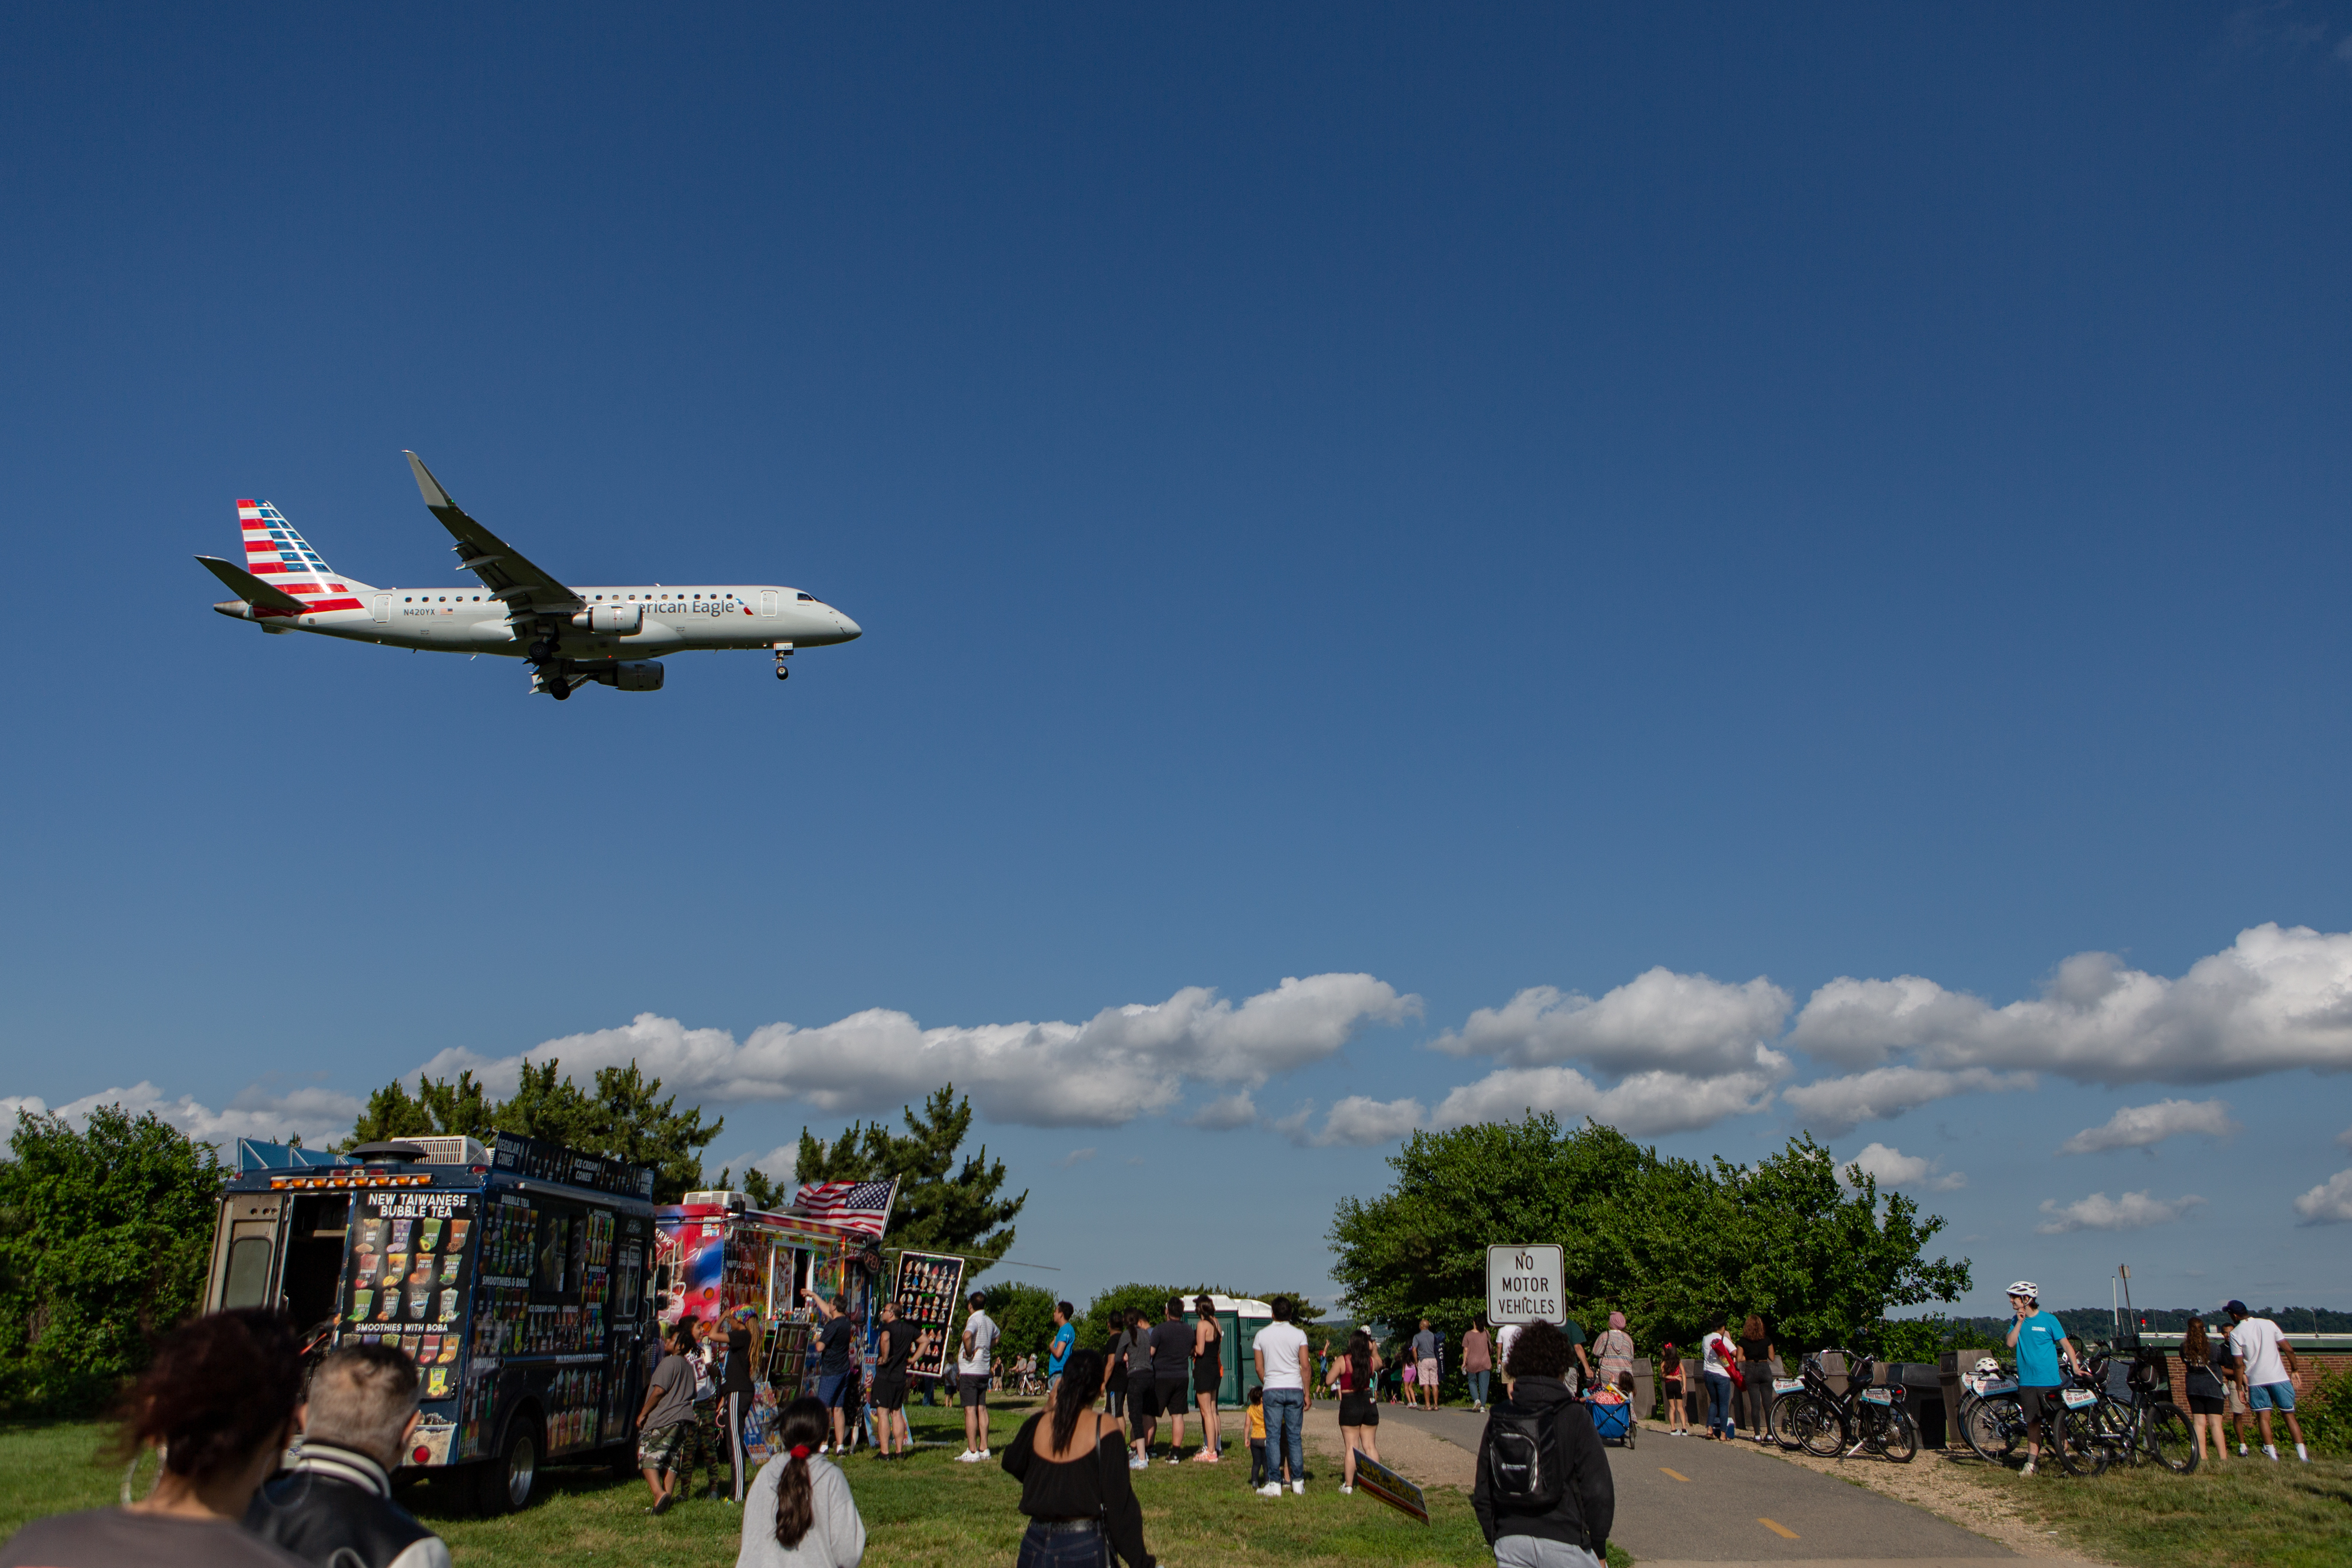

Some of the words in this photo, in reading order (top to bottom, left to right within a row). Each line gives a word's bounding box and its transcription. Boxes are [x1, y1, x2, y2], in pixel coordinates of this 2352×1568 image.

[693, 600, 735, 617] Eagle
[497, 1138, 520, 1155] REGULAR
[497, 1152, 515, 1167] CONES
[582, 1159, 599, 1172] CREAM
[575, 1171, 593, 1182] CONES!
[368, 1193, 396, 1205] NEW
[400, 1194, 468, 1207] TAIWANESE
[501, 1193, 520, 1207] BUBBLE
[520, 1197, 530, 1208] TEA
[380, 1205, 427, 1217] BUBBLE
[431, 1205, 453, 1217] TEA
[726, 1260, 742, 1269] WAFFLE
[742, 1261, 755, 1271] CONES
[863, 1251, 881, 1270] OPEN
[1516, 1255, 1533, 1270] NO
[482, 1275, 511, 1287] SMOOTHIES
[516, 1278, 529, 1287] BOBA
[1502, 1277, 1549, 1292] MOTOR
[1499, 1299, 1554, 1314] VEHICLES
[356, 1323, 402, 1332] SMOOTHIES
[406, 1324, 424, 1332] WITH
[426, 1324, 449, 1333] BOBA
[473, 1357, 496, 1369] DRINKS
[556, 1354, 583, 1364] MILKSHAKES
[1360, 1459, 1383, 1480] 5K
